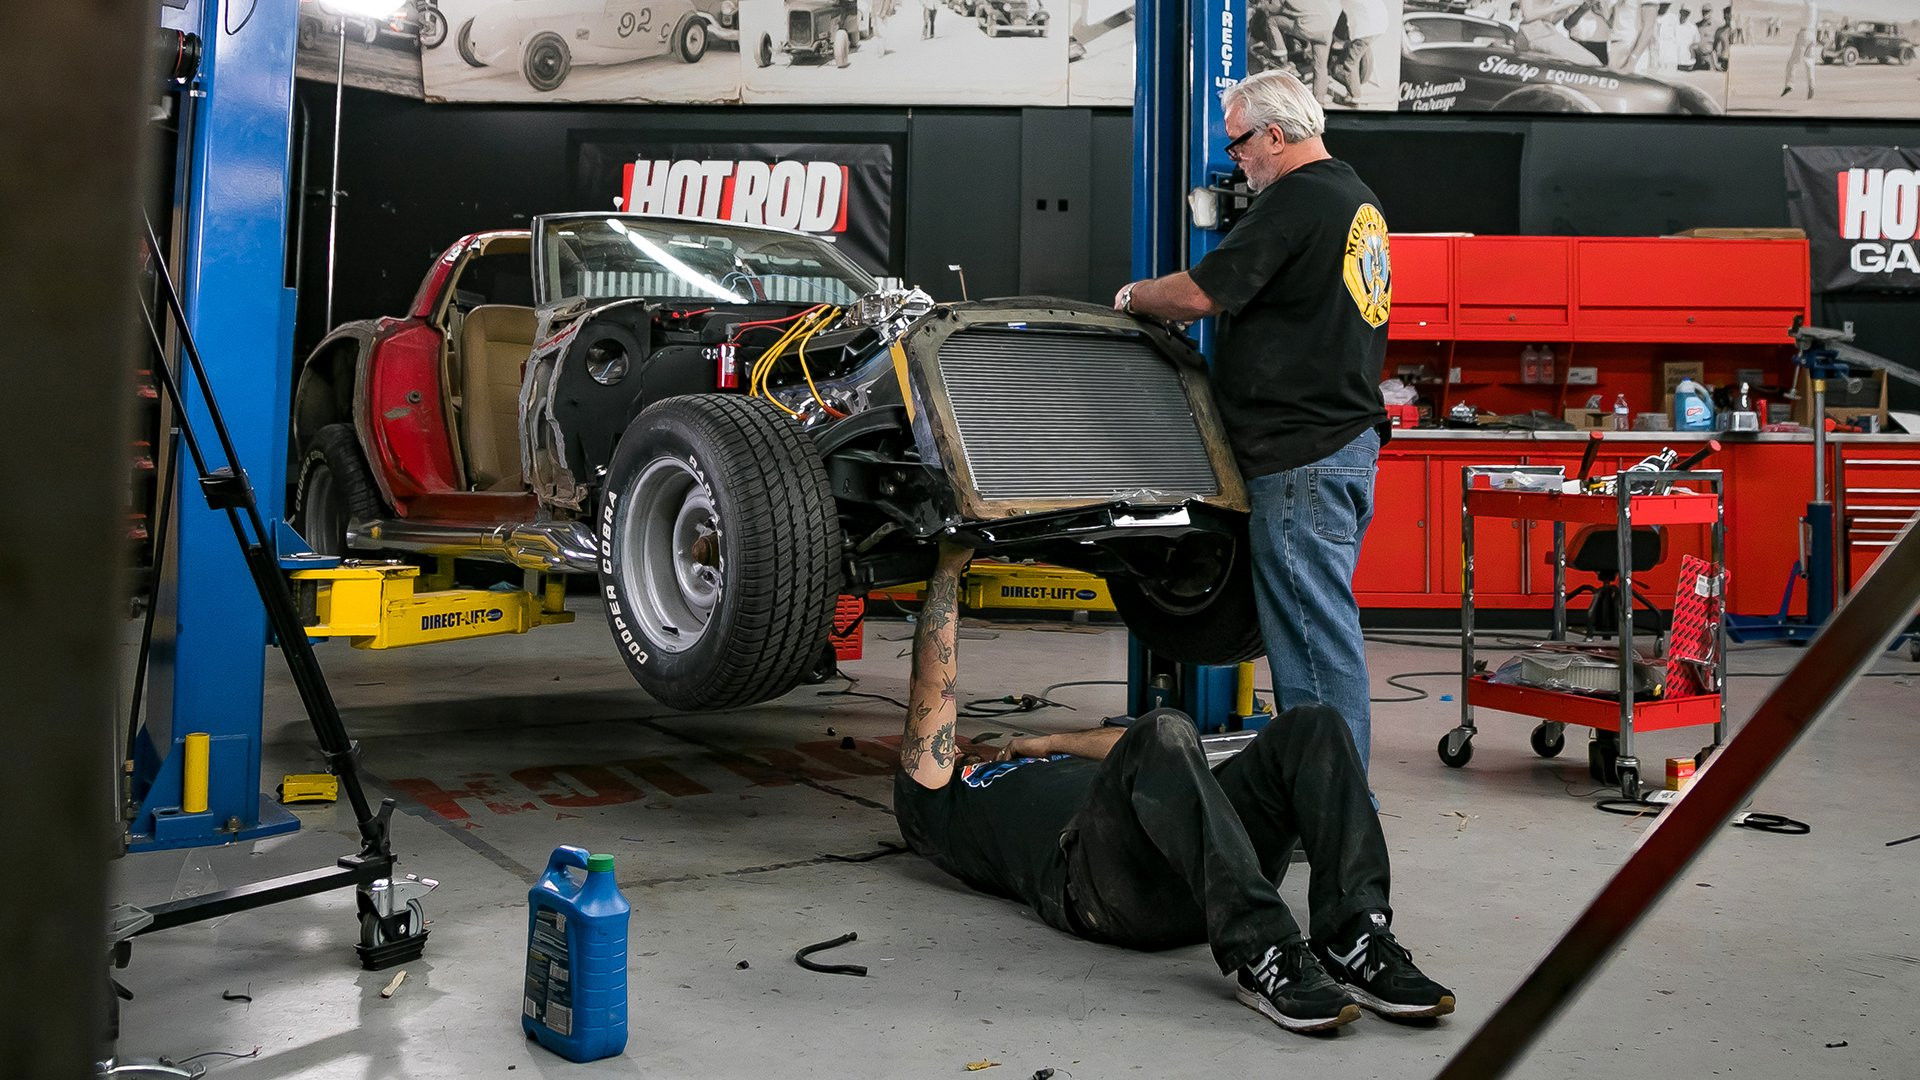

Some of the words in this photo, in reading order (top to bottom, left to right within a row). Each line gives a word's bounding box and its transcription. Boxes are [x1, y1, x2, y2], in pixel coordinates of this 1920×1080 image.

[617, 7, 652, 38] 92
[1478, 55, 1540, 82] Sharp
[1545, 69, 1620, 90] EQUIPPED
[1399, 77, 1467, 102] Chrisman's
[1412, 96, 1456, 112] Garage
[628, 160, 734, 219] HOT
[729, 160, 842, 232] ROD
[1844, 168, 1920, 240] HO
[602, 490, 618, 575] COBRA
[1001, 585, 1077, 600] DIRECT-LIFT
[421, 609, 487, 631] DIRECT-LIFT
[606, 585, 649, 665] COOPER
